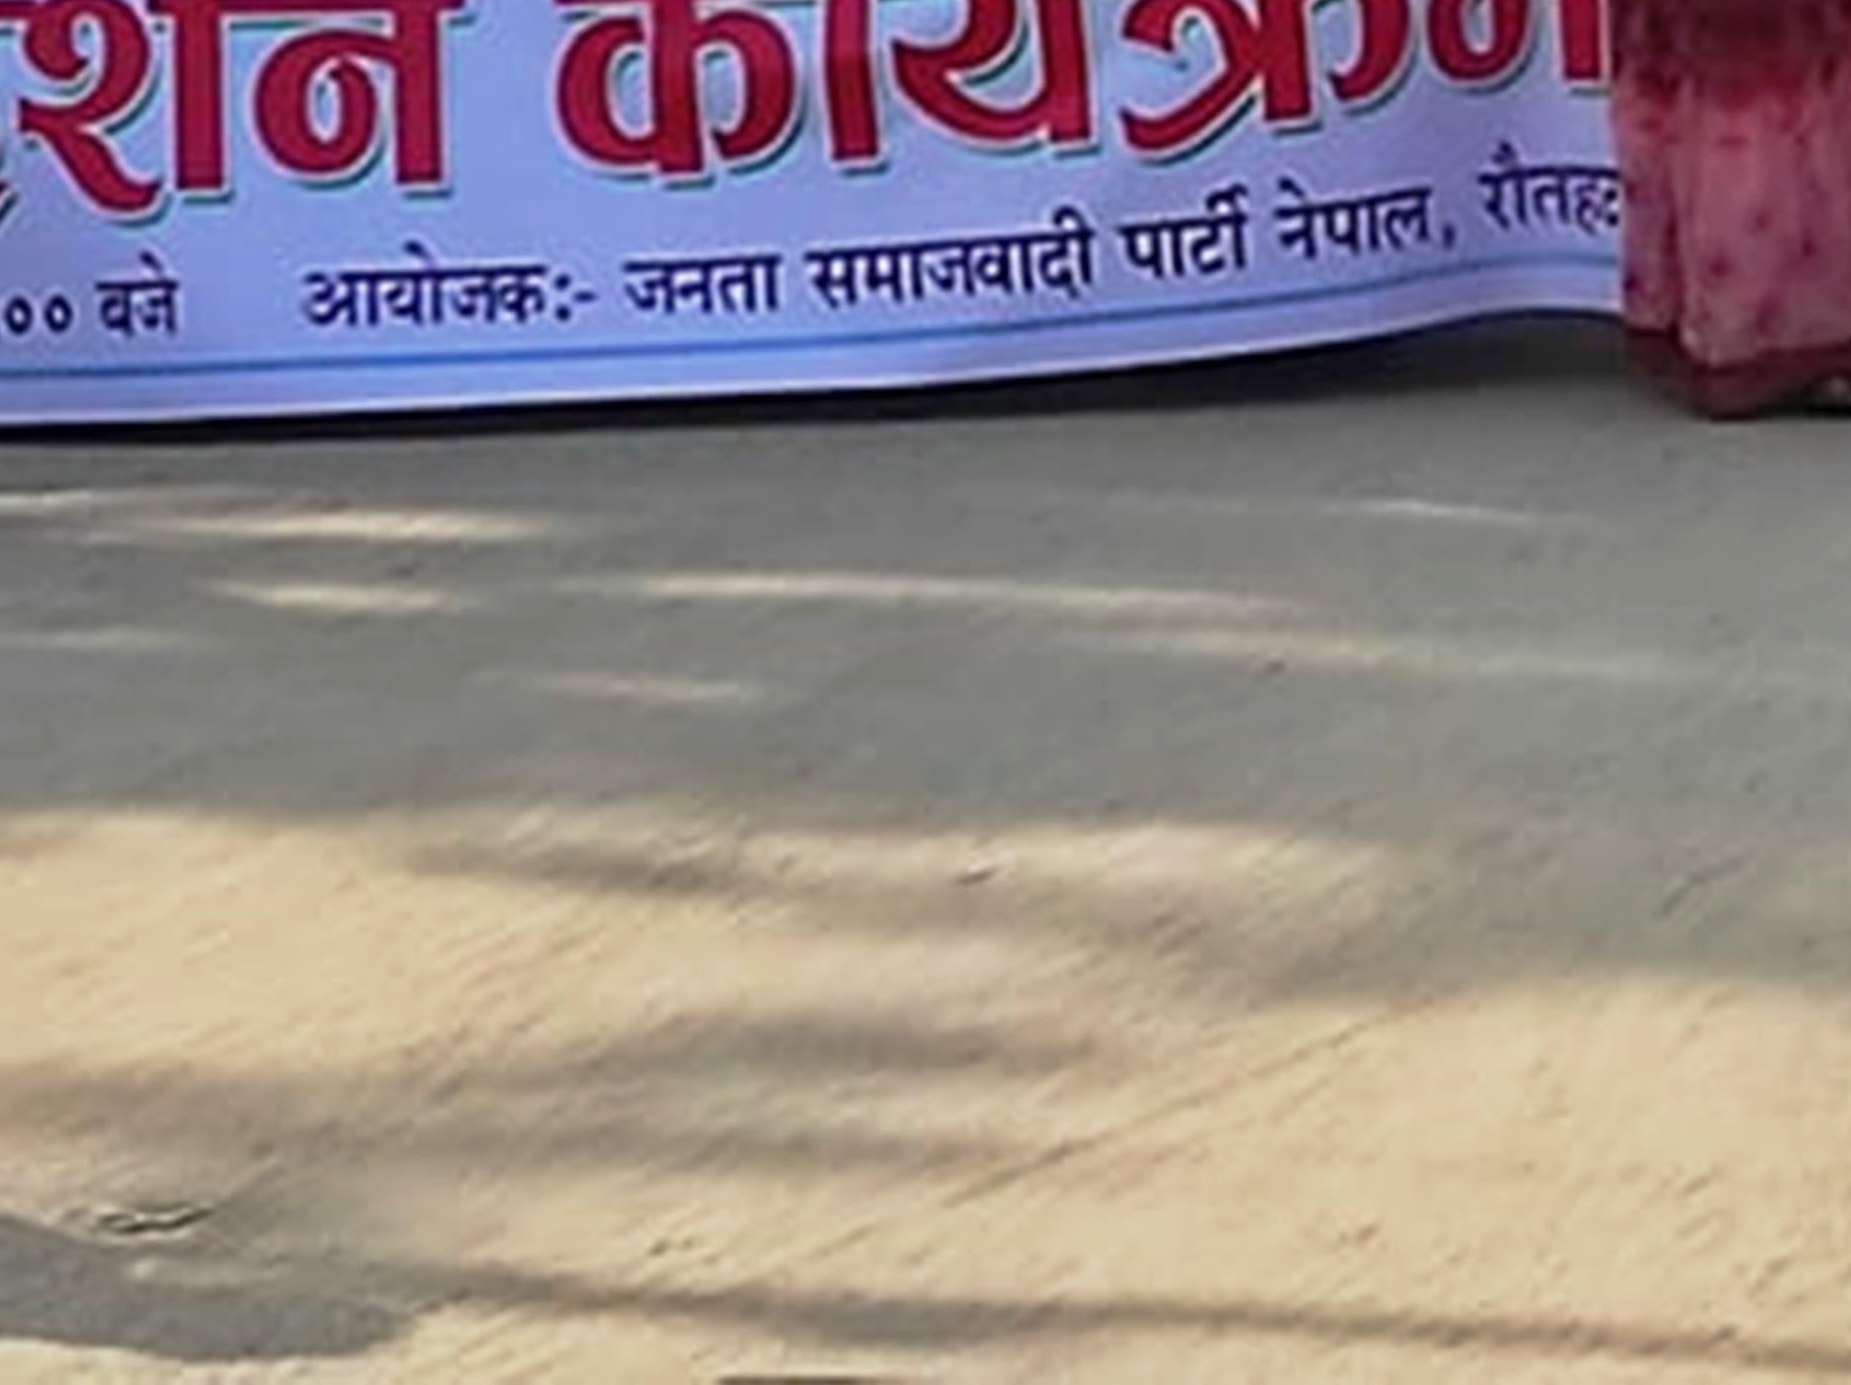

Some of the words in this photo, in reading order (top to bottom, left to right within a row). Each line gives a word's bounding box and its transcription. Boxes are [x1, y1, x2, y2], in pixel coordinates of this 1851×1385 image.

[626, 253, 782, 316] जनता
[806, 210, 1095, 308] समाजवादी
[1115, 184, 1249, 279] पार्टी
